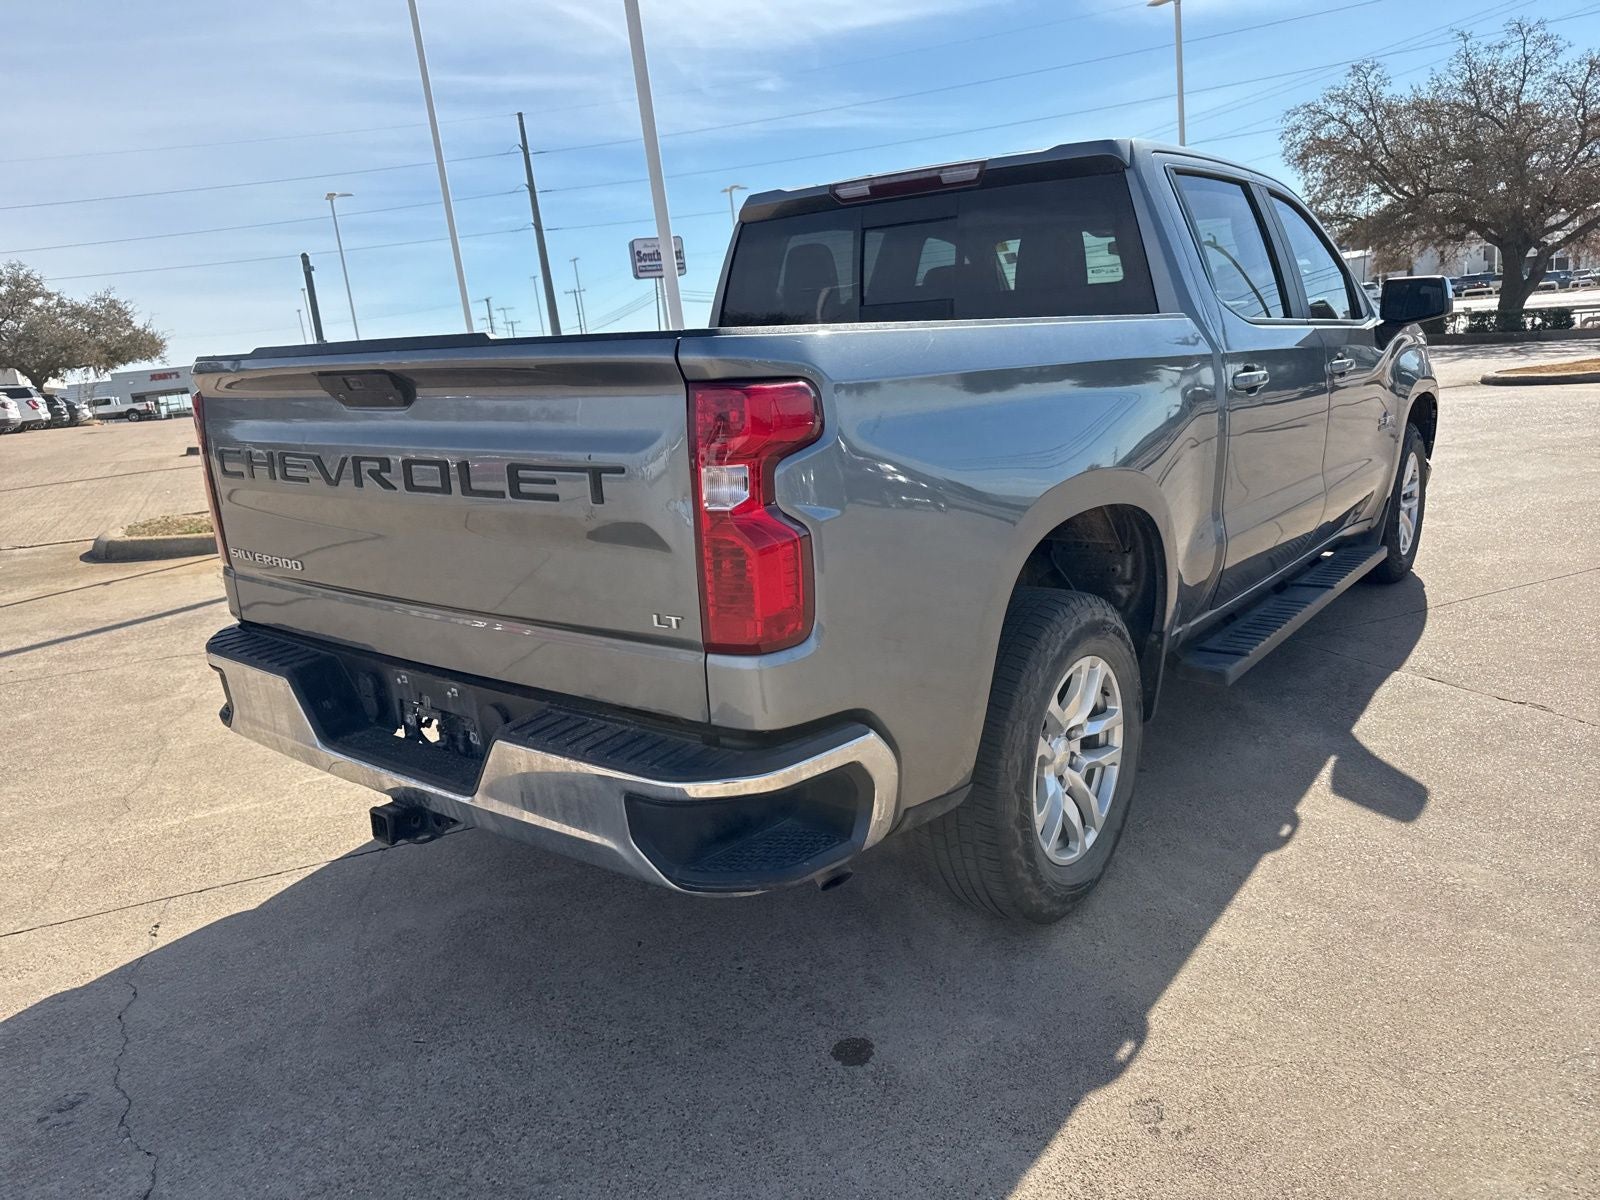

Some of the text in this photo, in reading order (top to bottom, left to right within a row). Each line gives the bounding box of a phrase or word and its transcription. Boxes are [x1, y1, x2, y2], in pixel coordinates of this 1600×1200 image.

[635, 249, 683, 263] Southst
[217, 446, 626, 506] CHEVROLET
[230, 547, 303, 571] SILVERADO
[652, 613, 684, 630] LT
